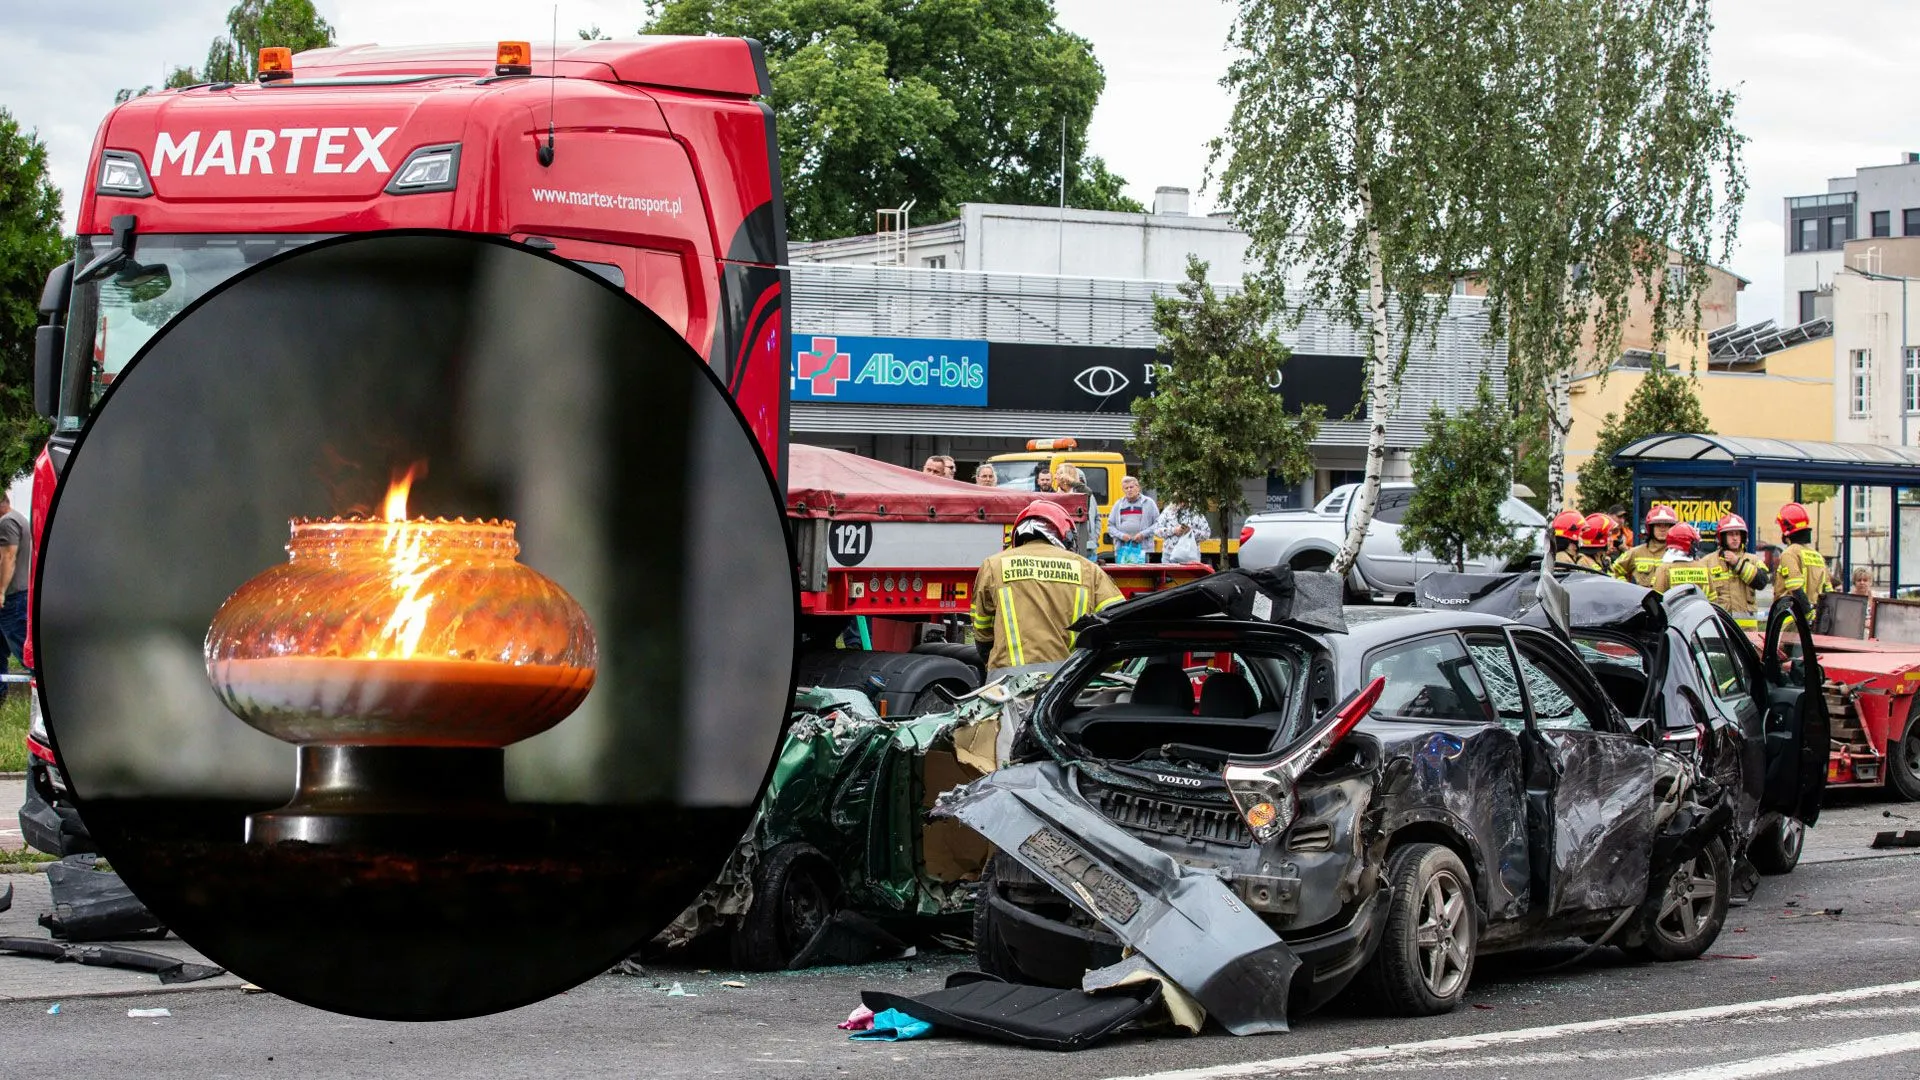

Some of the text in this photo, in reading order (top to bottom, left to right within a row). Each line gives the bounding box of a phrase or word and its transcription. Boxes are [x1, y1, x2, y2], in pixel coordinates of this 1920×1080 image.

[150, 126, 399, 177] MARTEX
[532, 187, 682, 219] www.martex-transport.pl
[835, 524, 867, 555] 121
[1010, 556, 1072, 571] PAŃSTWOWA
[1156, 773, 1202, 787] VOLVO
